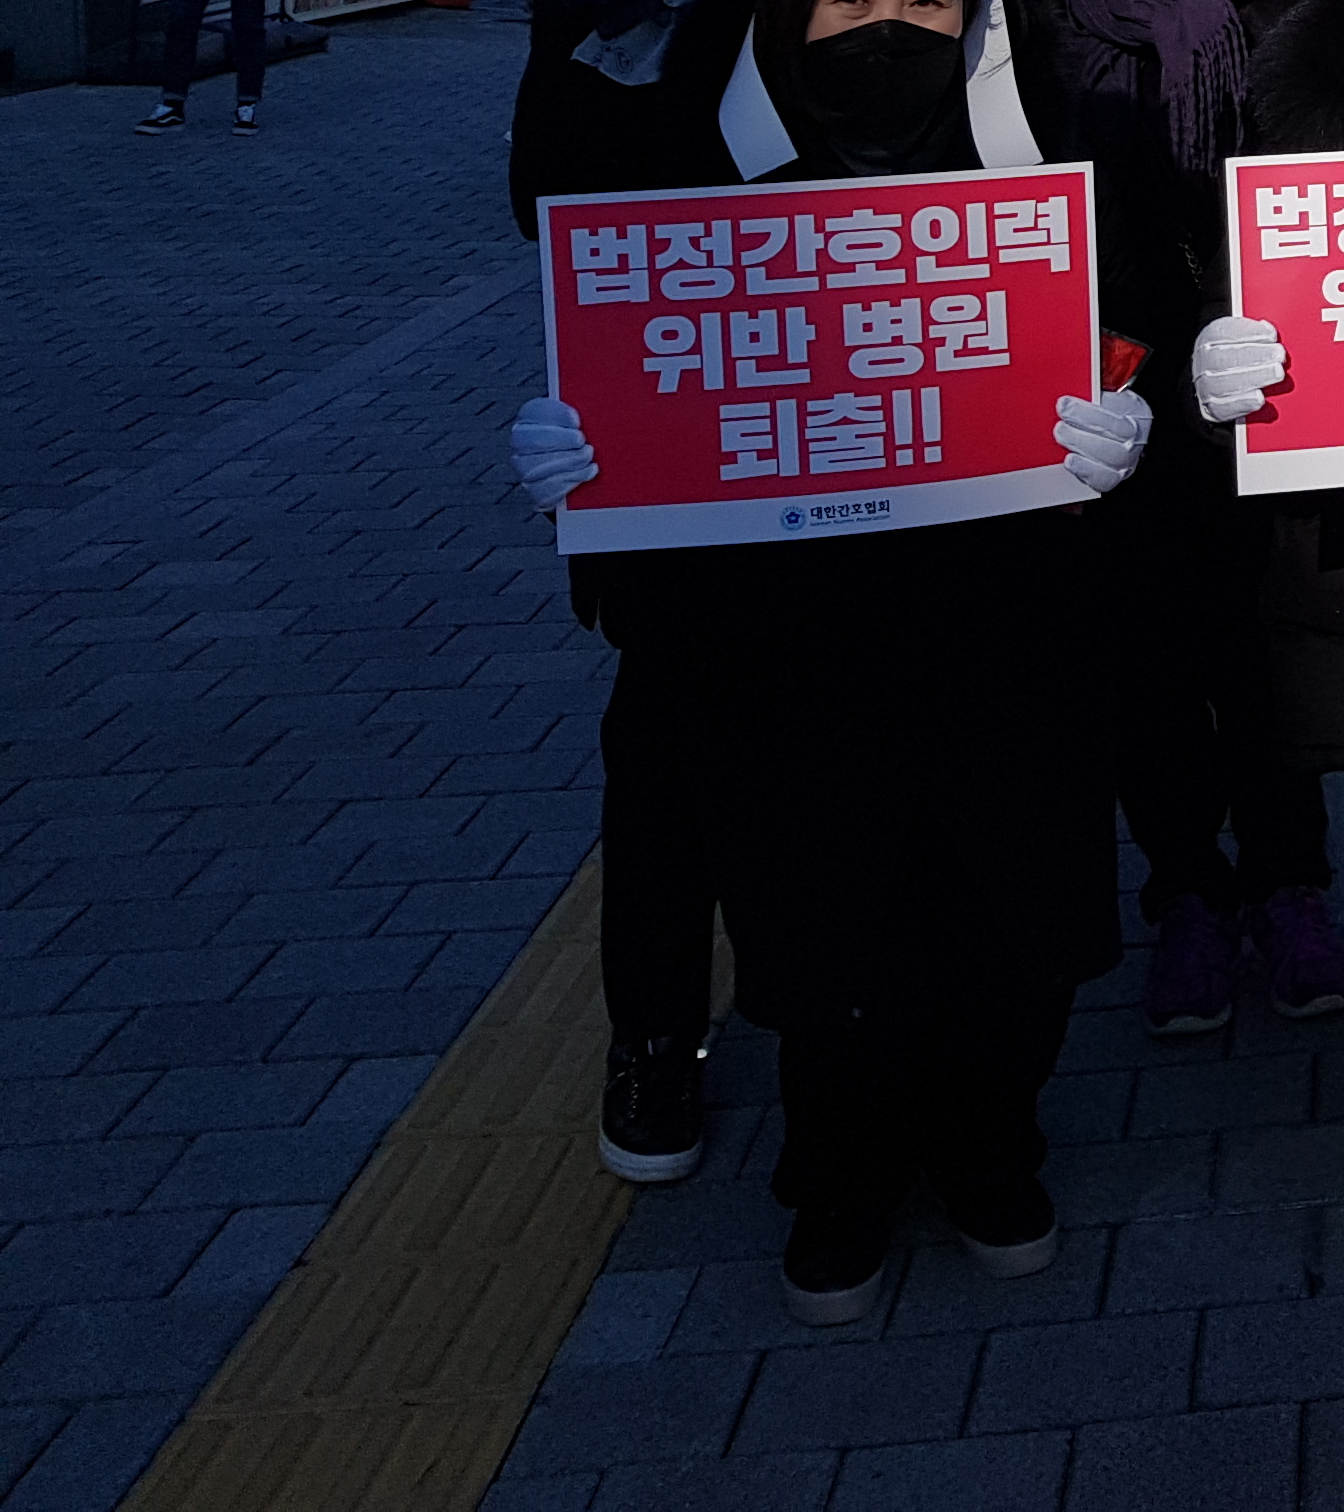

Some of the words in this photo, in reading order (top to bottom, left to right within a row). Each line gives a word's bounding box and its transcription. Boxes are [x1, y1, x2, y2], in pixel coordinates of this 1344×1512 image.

[569, 195, 1071, 306] 법정간호인력
[642, 306, 816, 394] 위반
[842, 290, 1011, 380] 병원
[718, 386, 943, 482] 퇴출!!
[810, 500, 891, 520] 대한간호협회
